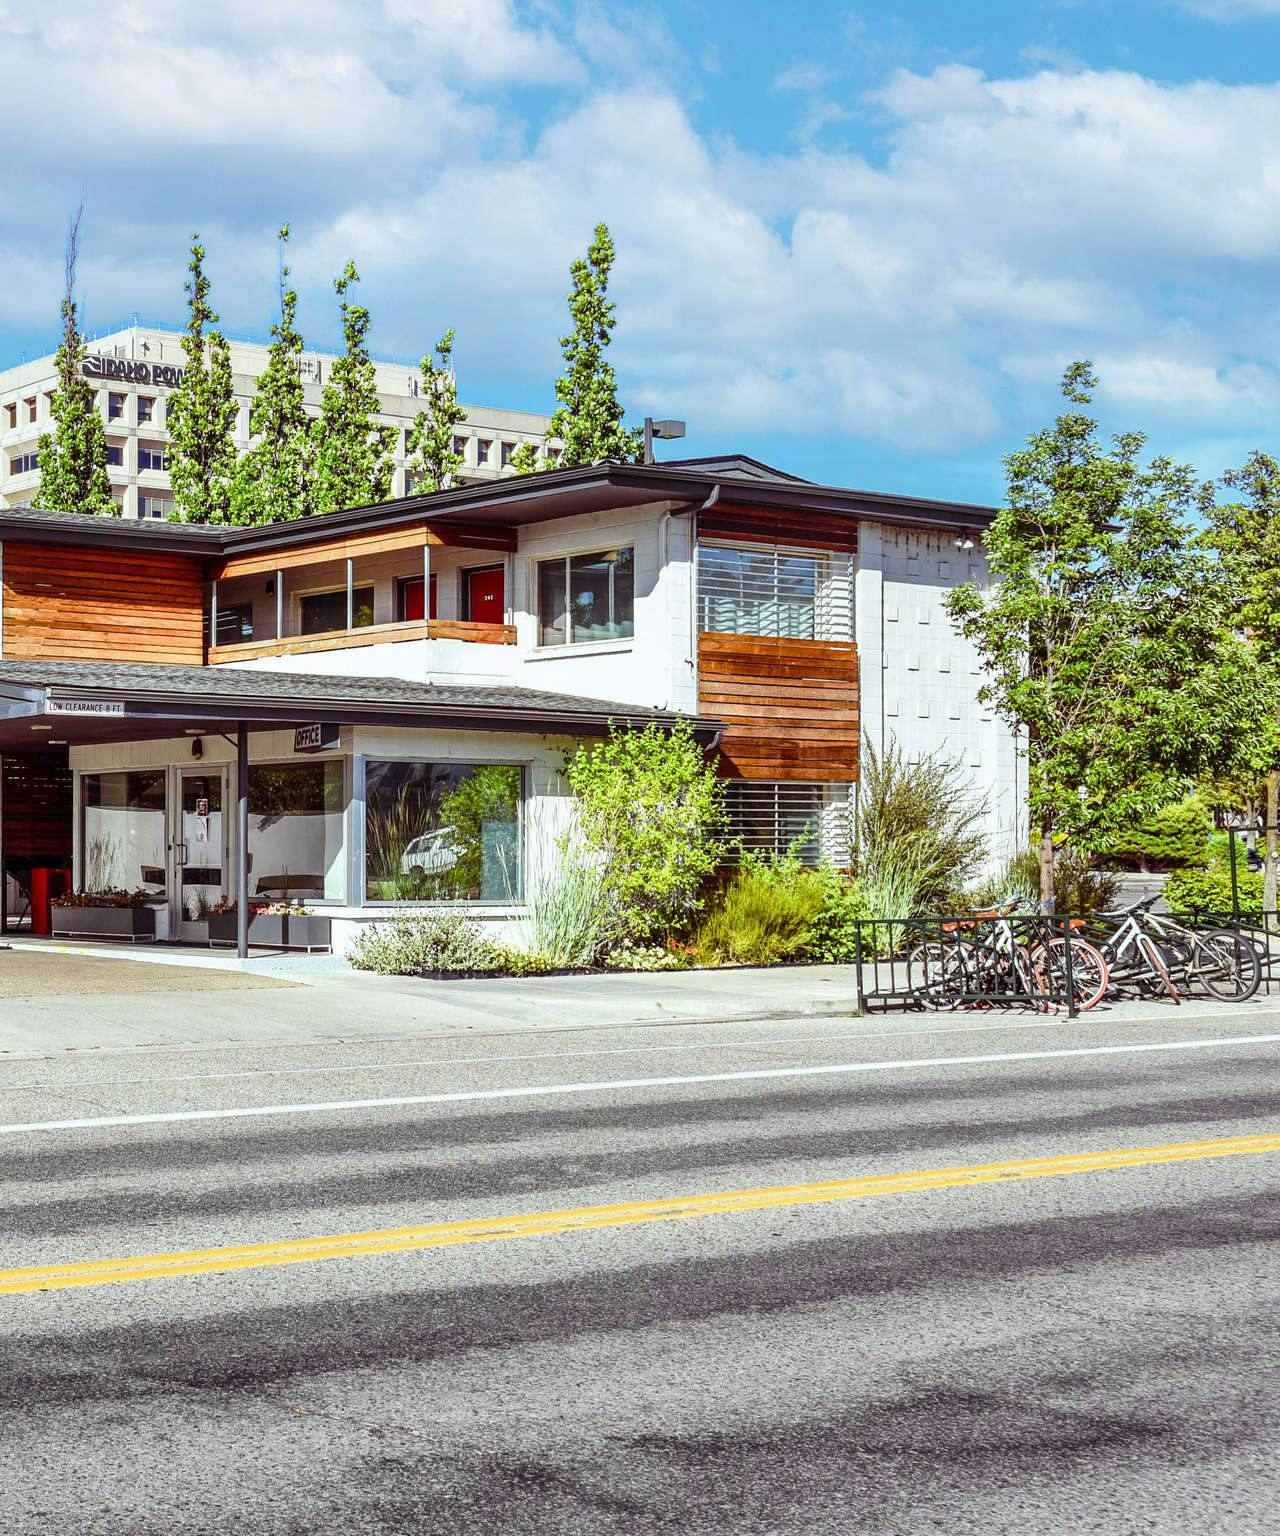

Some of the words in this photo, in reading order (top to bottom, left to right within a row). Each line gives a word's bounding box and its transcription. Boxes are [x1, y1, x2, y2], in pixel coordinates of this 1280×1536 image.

[101, 358, 150, 384] IDAHO
[152, 365, 190, 388] POW
[49, 702, 63, 711] LOW
[65, 702, 103, 713] CLEARANCE
[112, 704, 121, 713] FT
[296, 726, 320, 747] OFFICE
